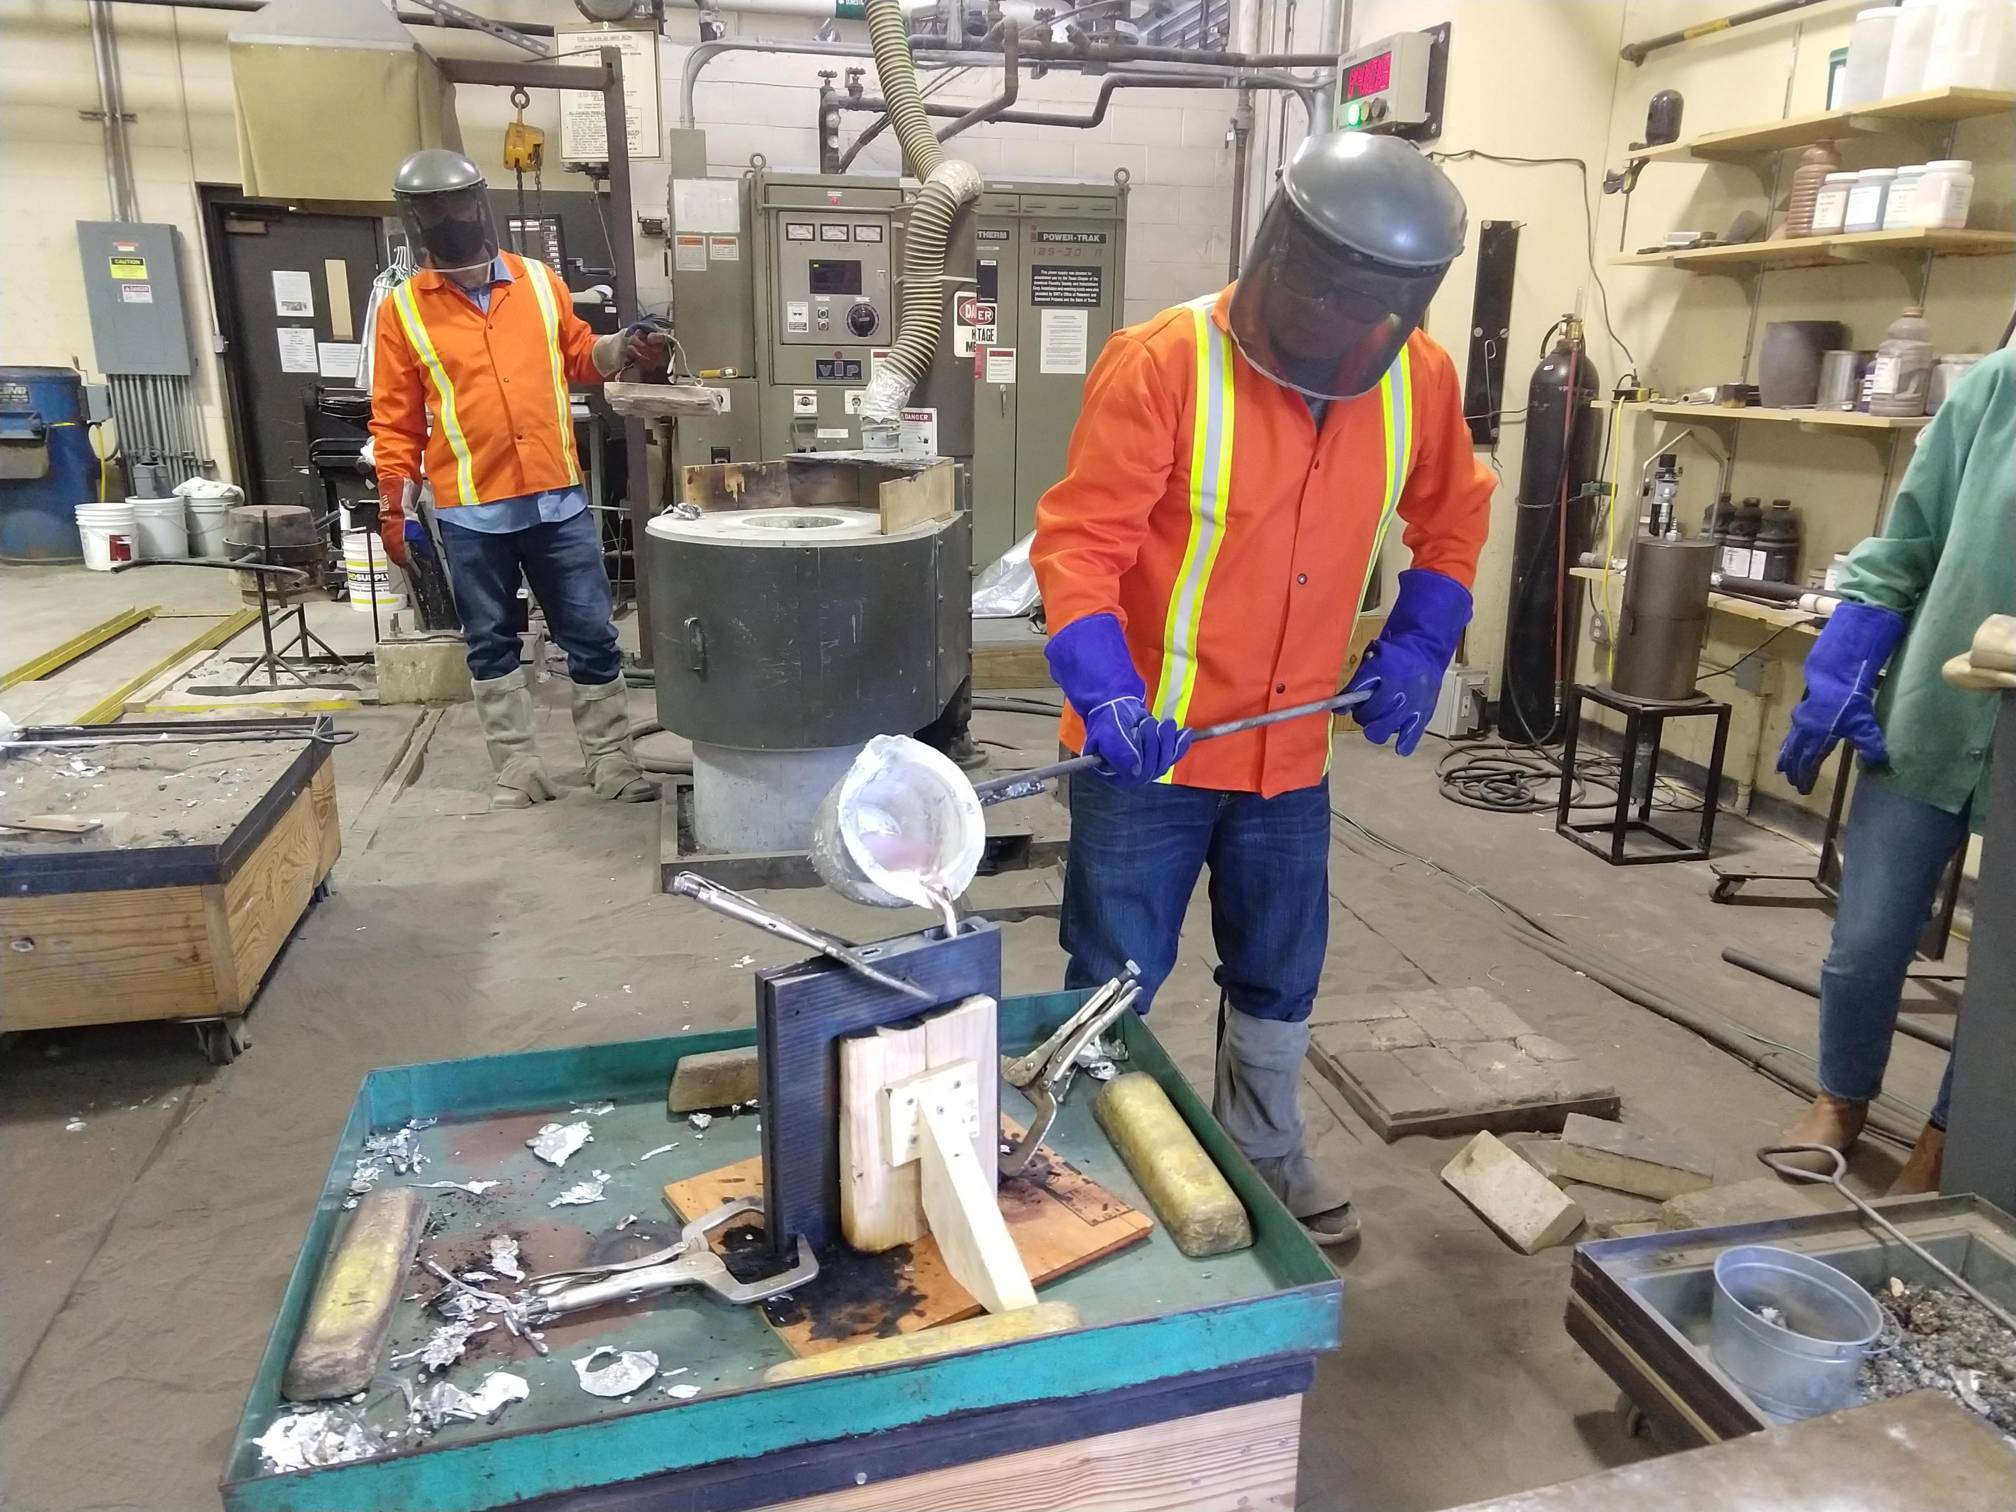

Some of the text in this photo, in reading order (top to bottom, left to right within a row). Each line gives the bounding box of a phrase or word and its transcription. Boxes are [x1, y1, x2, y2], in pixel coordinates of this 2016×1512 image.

[977, 231, 1008, 239] THERM
[977, 328, 995, 342] TAGE
[904, 413, 928, 421] DANGER
